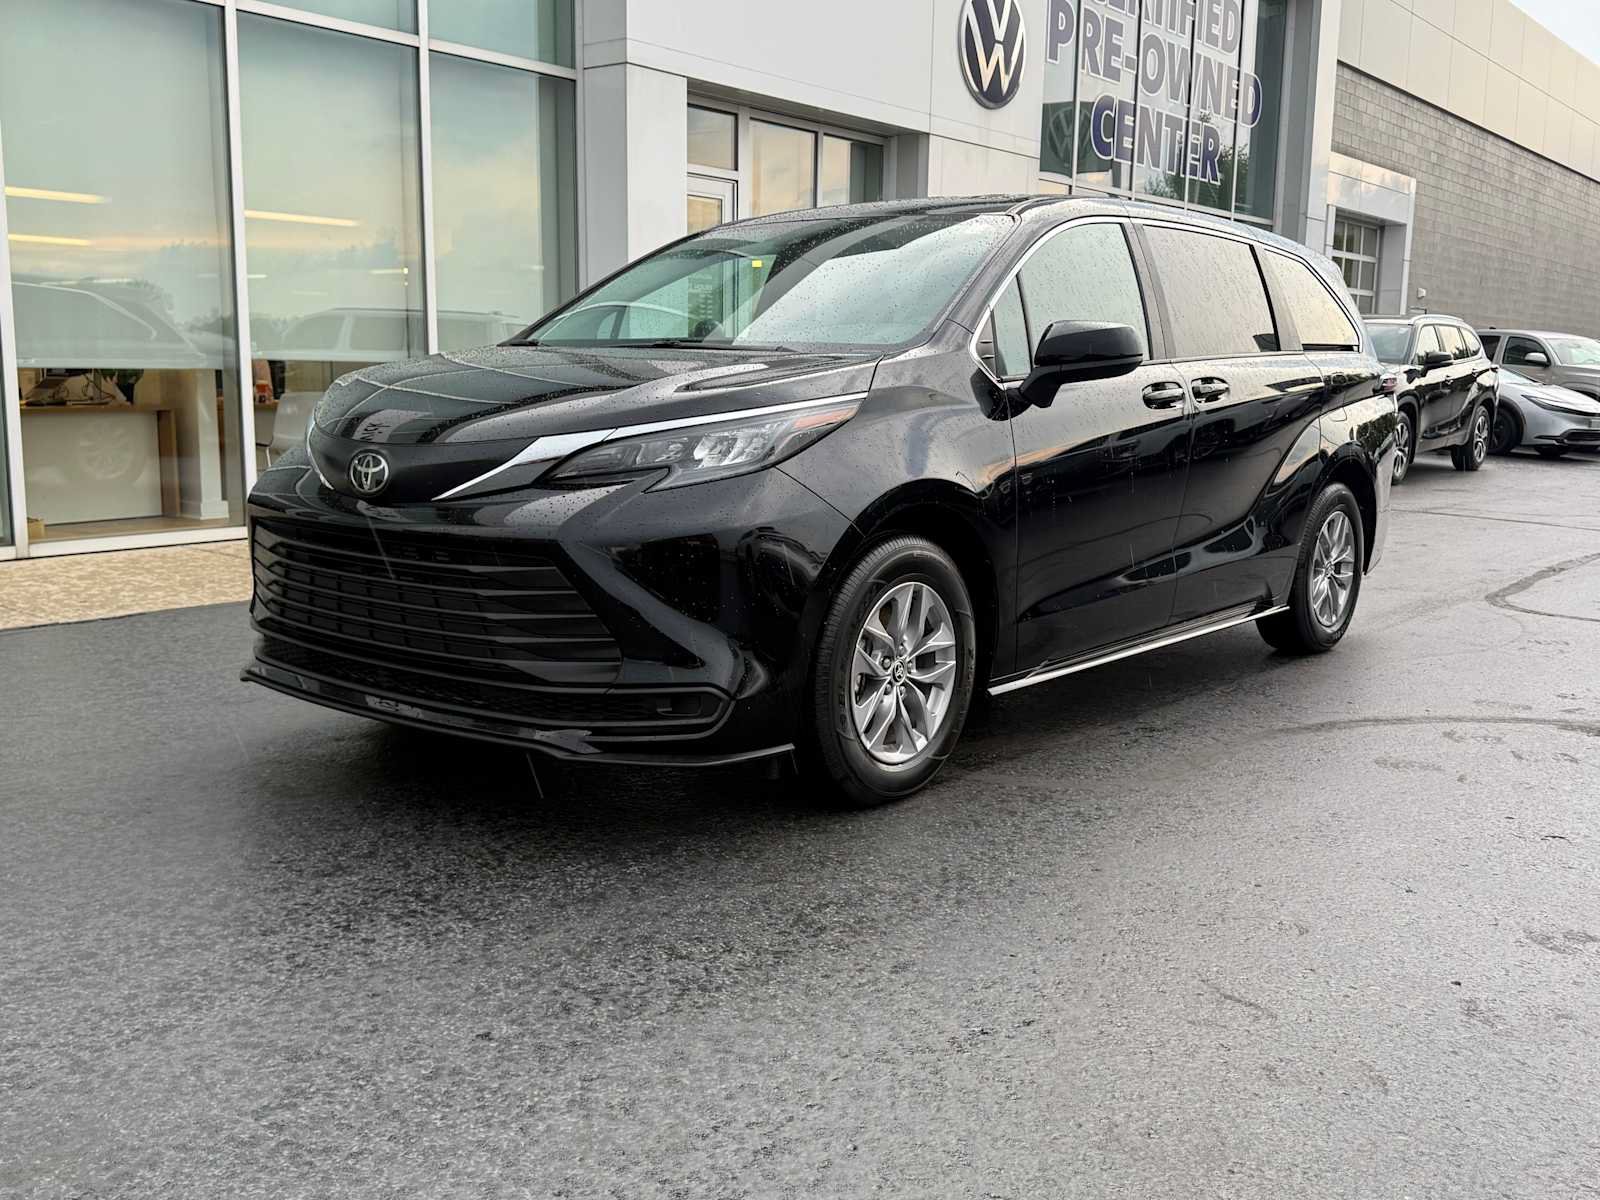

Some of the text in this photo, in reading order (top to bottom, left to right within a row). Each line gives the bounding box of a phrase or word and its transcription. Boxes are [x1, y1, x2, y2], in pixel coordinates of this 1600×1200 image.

[1046, 0, 1262, 128] PRE-OWNED
[1094, 0, 1242, 53] IFIED
[1091, 94, 1221, 185] CENTER
